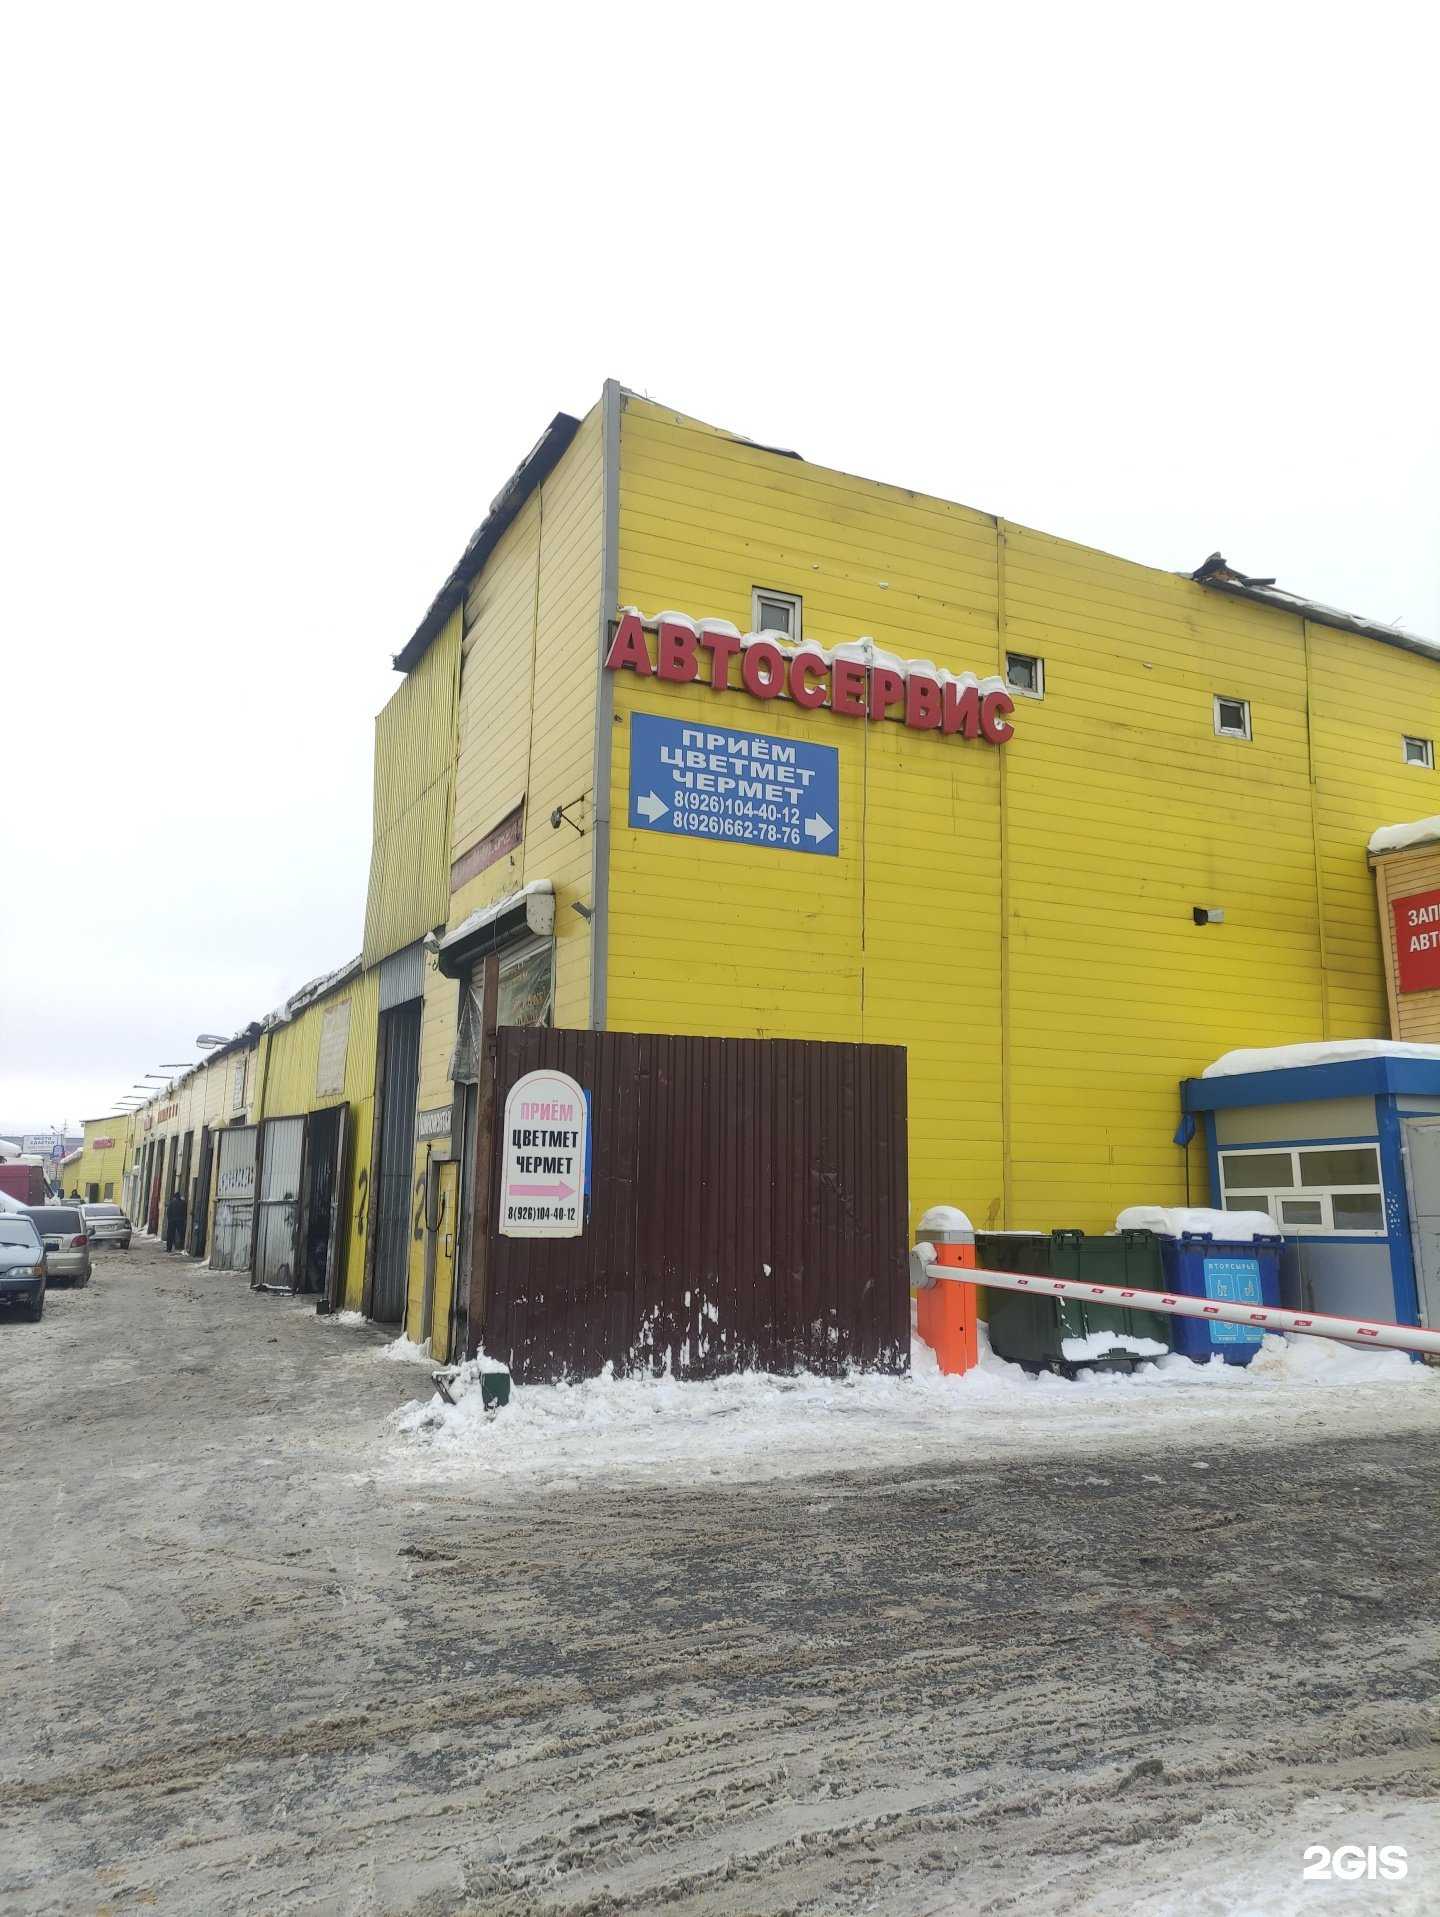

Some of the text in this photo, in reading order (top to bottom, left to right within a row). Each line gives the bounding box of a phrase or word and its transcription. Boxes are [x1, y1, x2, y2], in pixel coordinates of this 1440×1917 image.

[605, 613, 1015, 745] АВТОСЕРВИС
[682, 729, 797, 764] ПРИЁМ
[660, 746, 816, 786] ЦВЕТМЕТ
[672, 769, 804, 805] ЧЕРМЕТ
[674, 791, 800, 825] 8(926)104-40-12
[673, 811, 800, 845] 8(926)662-78-76
[1408, 904, 1440, 927] ЗАП
[1409, 931, 1440, 953] АВТ
[520, 1100, 574, 1122] ПРИЁМ
[512, 1129, 579, 1149] ЦВЕТМЕТ
[516, 1156, 573, 1175] ЧЕРМЕТ
[507, 1206, 576, 1221] 8(926)104-40-12
